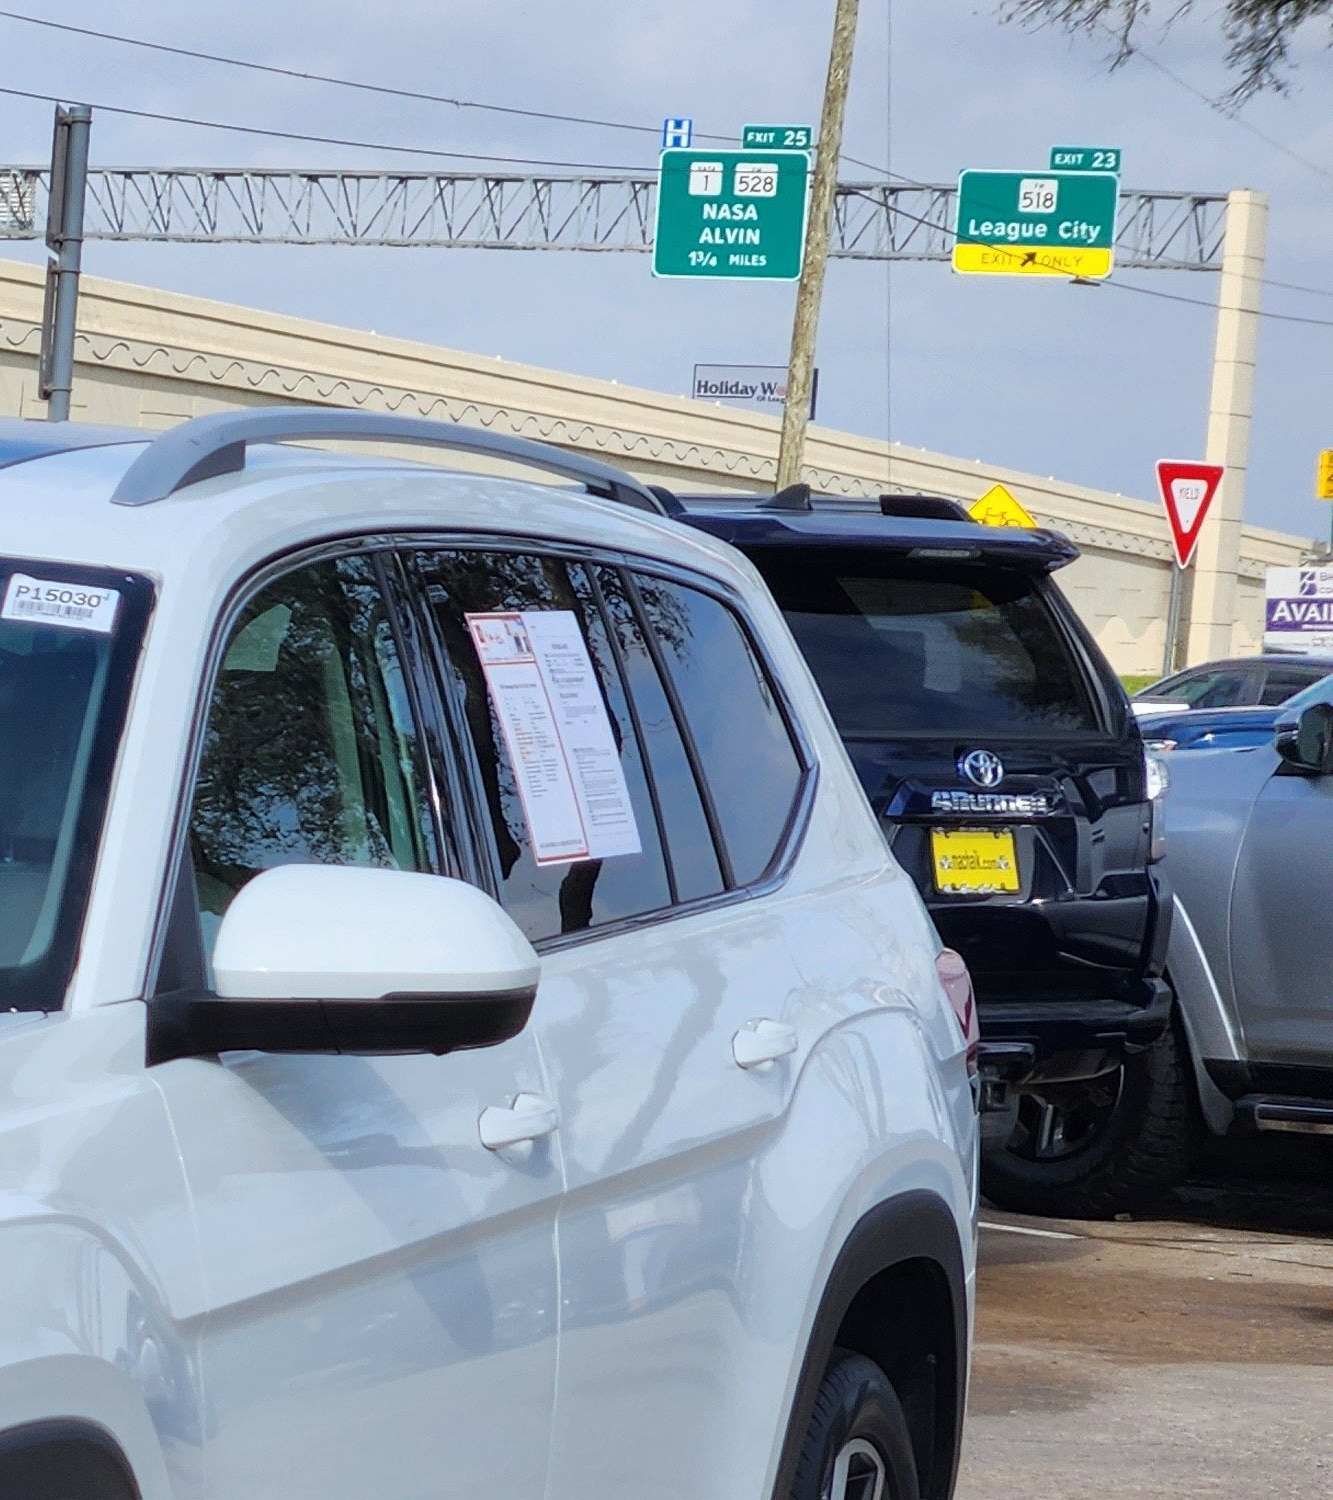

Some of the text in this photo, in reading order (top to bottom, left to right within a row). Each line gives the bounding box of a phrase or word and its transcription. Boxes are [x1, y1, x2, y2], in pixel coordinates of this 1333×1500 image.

[747, 130, 807, 146] EXIT 25
[1054, 152, 1116, 168] EXIT 23
[738, 175, 773, 192] 528
[1021, 191, 1054, 209] 518
[703, 203, 758, 220] NASA
[699, 227, 760, 245] ALVIN
[968, 219, 1101, 243] League City
[729, 254, 767, 266] MILES
[981, 253, 1085, 267] EXIT ONLY
[696, 379, 758, 397] Holiday
[15, 585, 101, 608] P15030
[1271, 600, 1333, 621] AVAI
